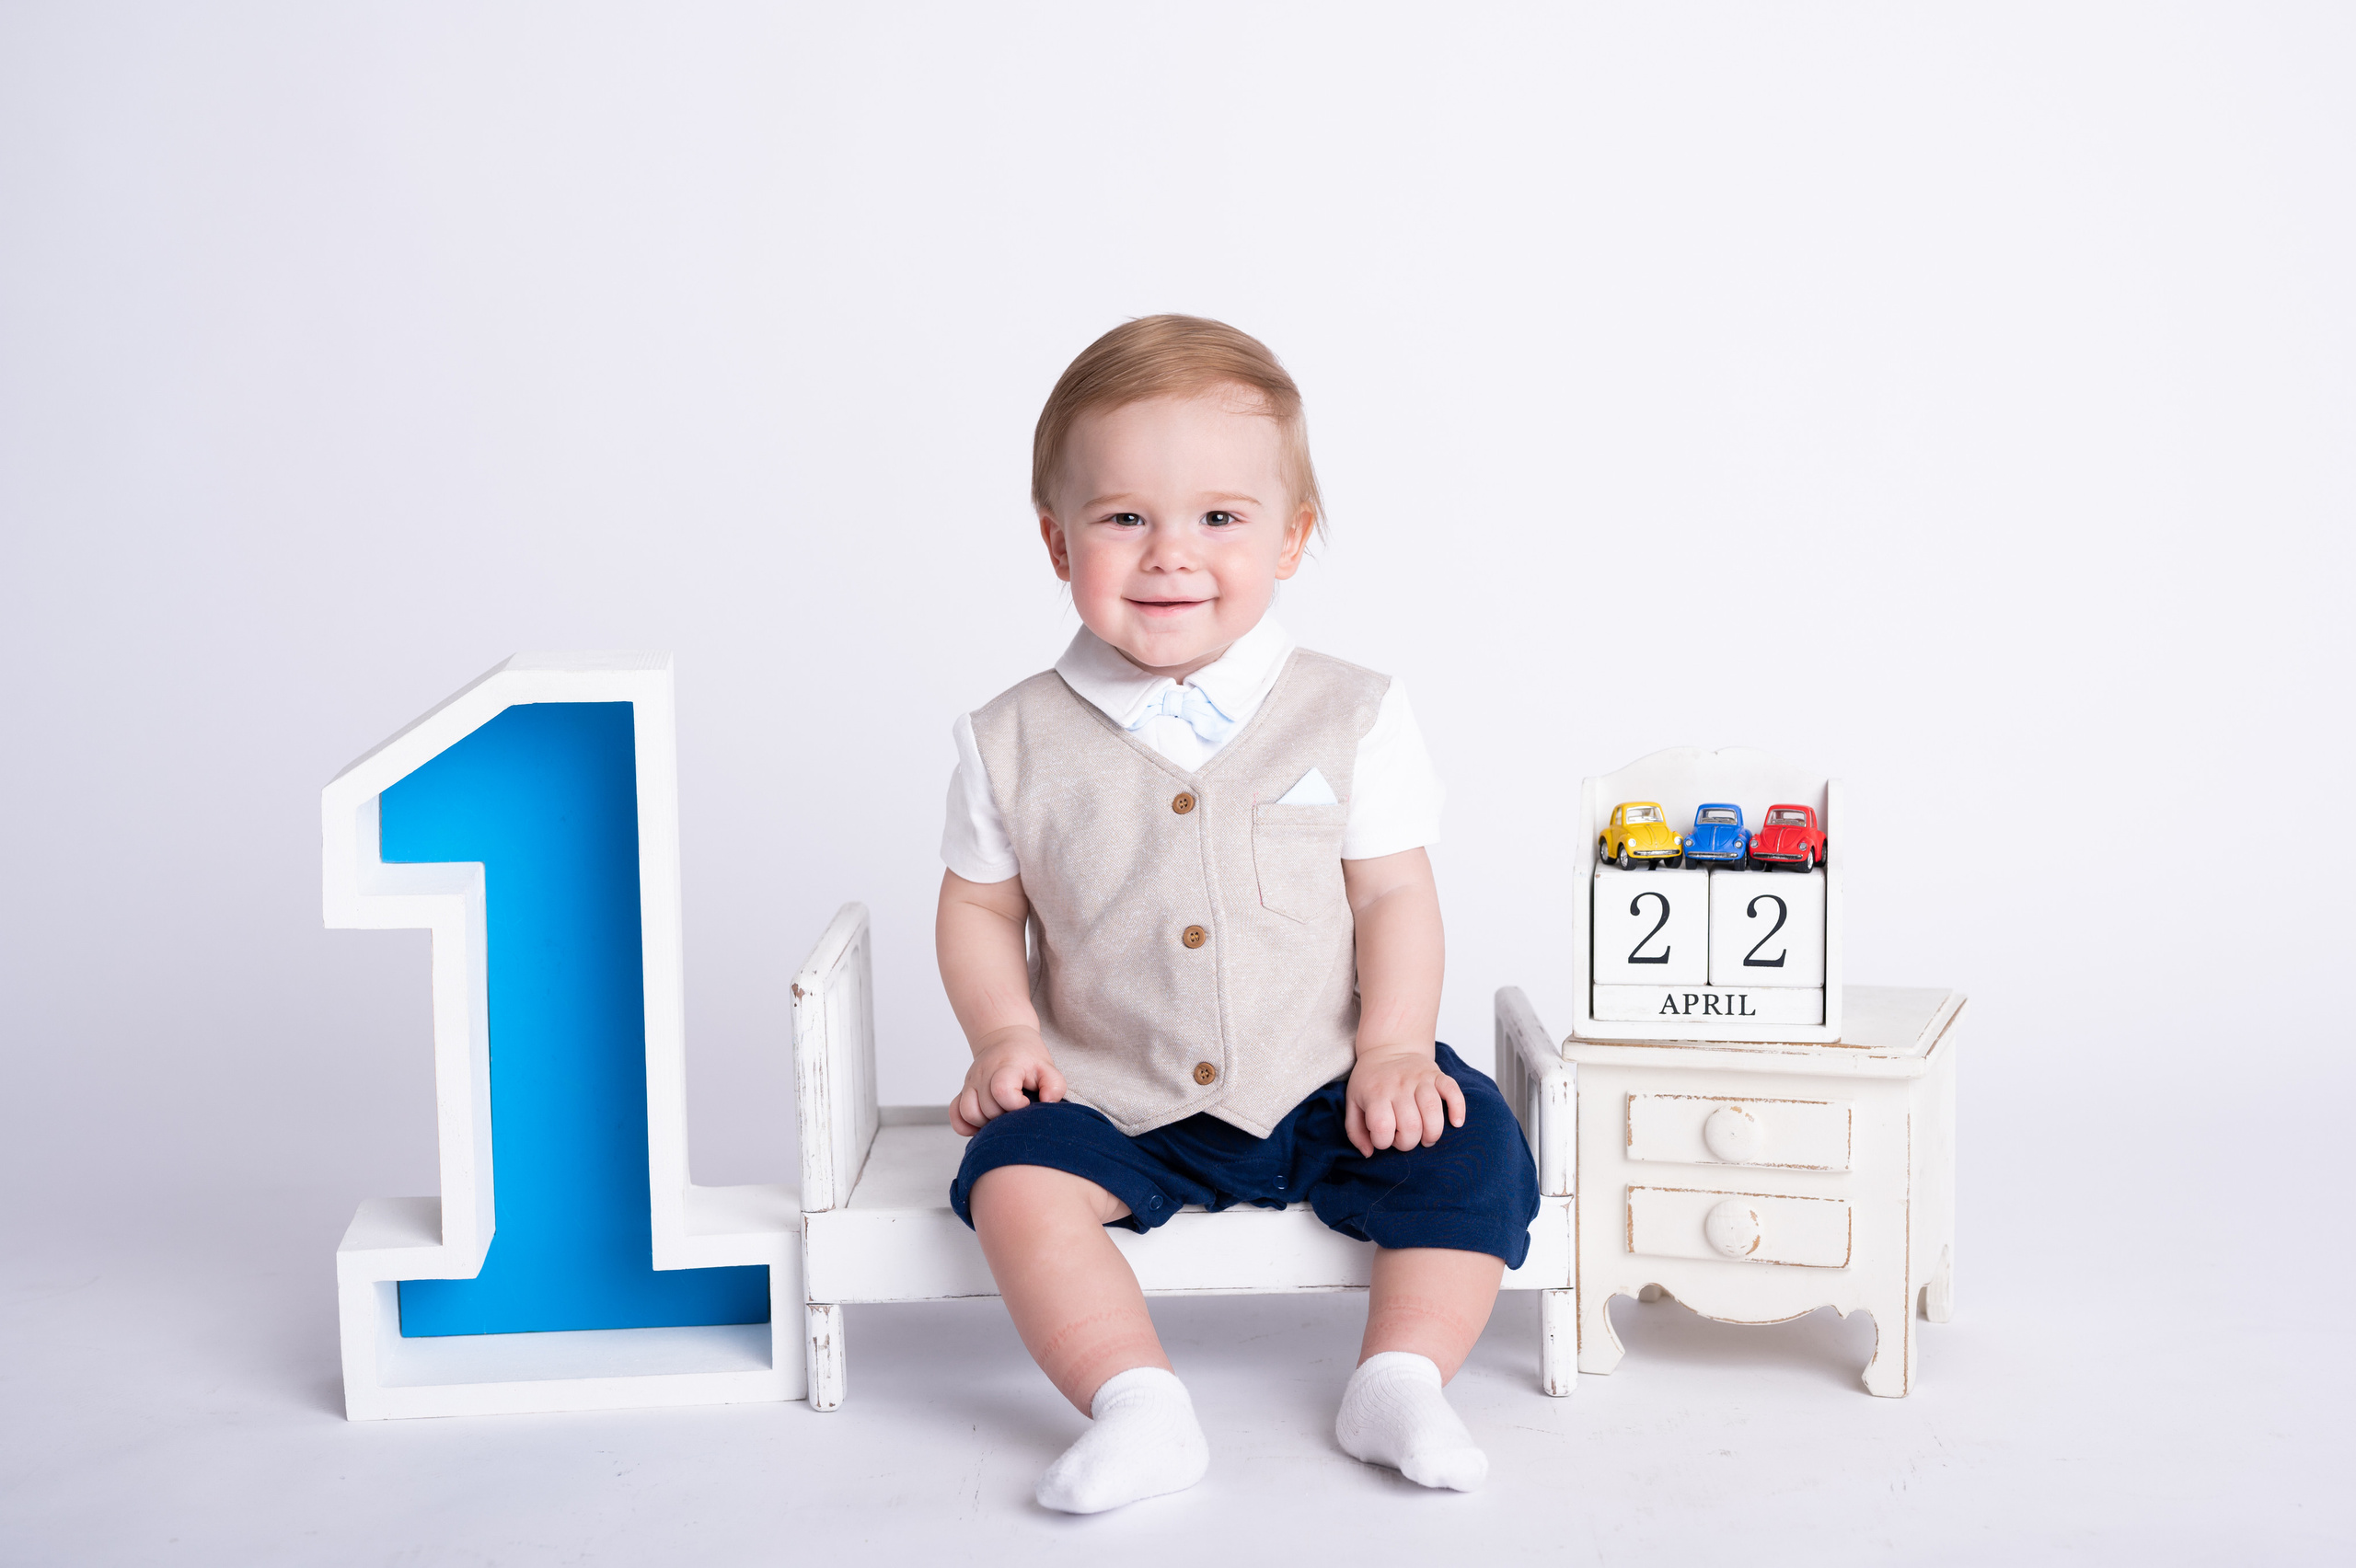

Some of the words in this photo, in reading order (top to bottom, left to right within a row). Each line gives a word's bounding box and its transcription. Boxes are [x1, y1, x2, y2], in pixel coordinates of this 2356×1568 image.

[1627, 892, 1671, 964] 2
[1742, 894, 1787, 968] 2
[323, 653, 804, 1420] 1
[1658, 993, 1756, 1017] APRIL
